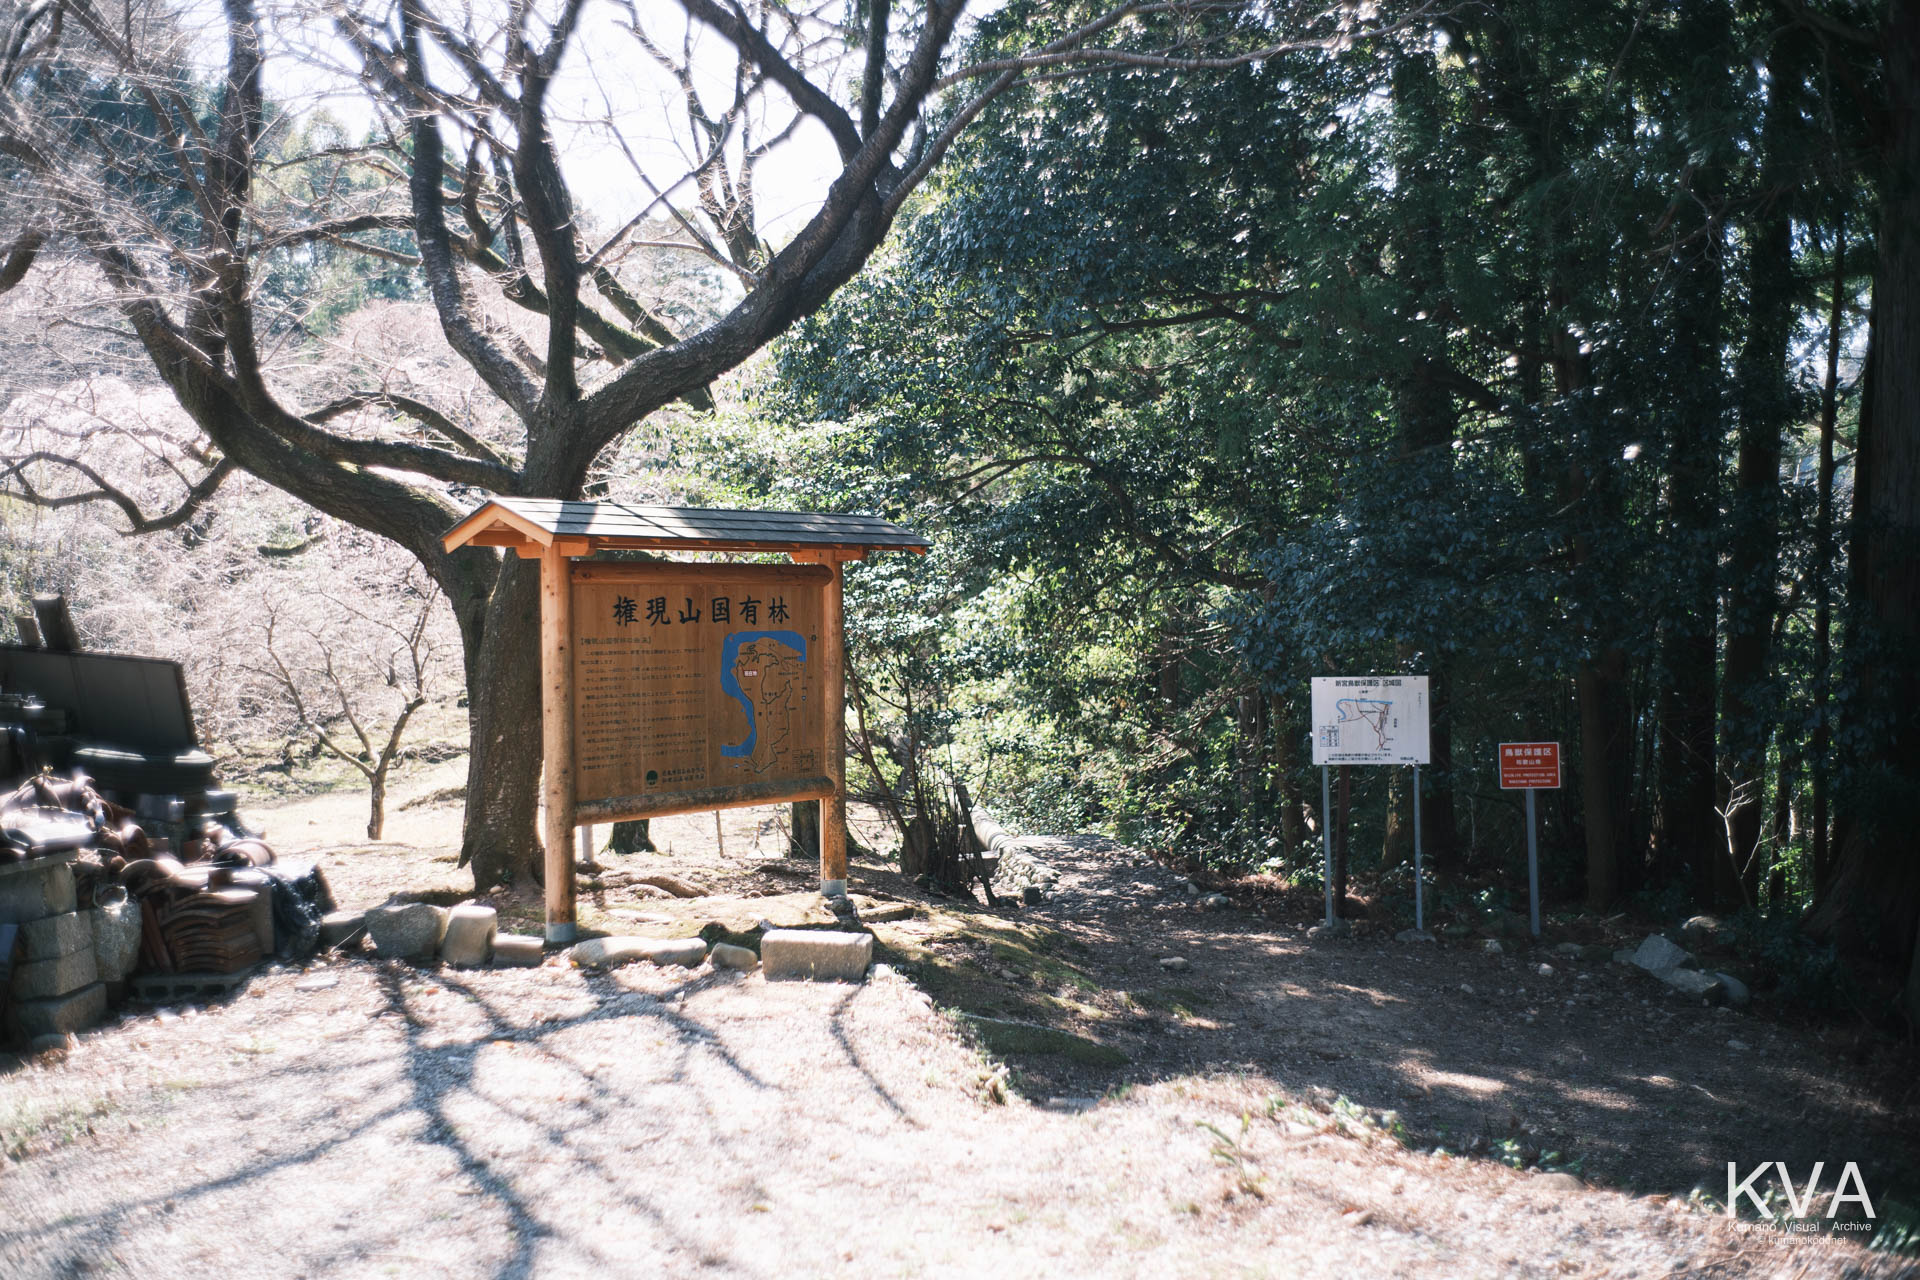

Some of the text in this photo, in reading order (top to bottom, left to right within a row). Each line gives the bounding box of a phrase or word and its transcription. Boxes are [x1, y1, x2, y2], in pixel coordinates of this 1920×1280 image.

[612, 594, 791, 627] 権現山国有林
